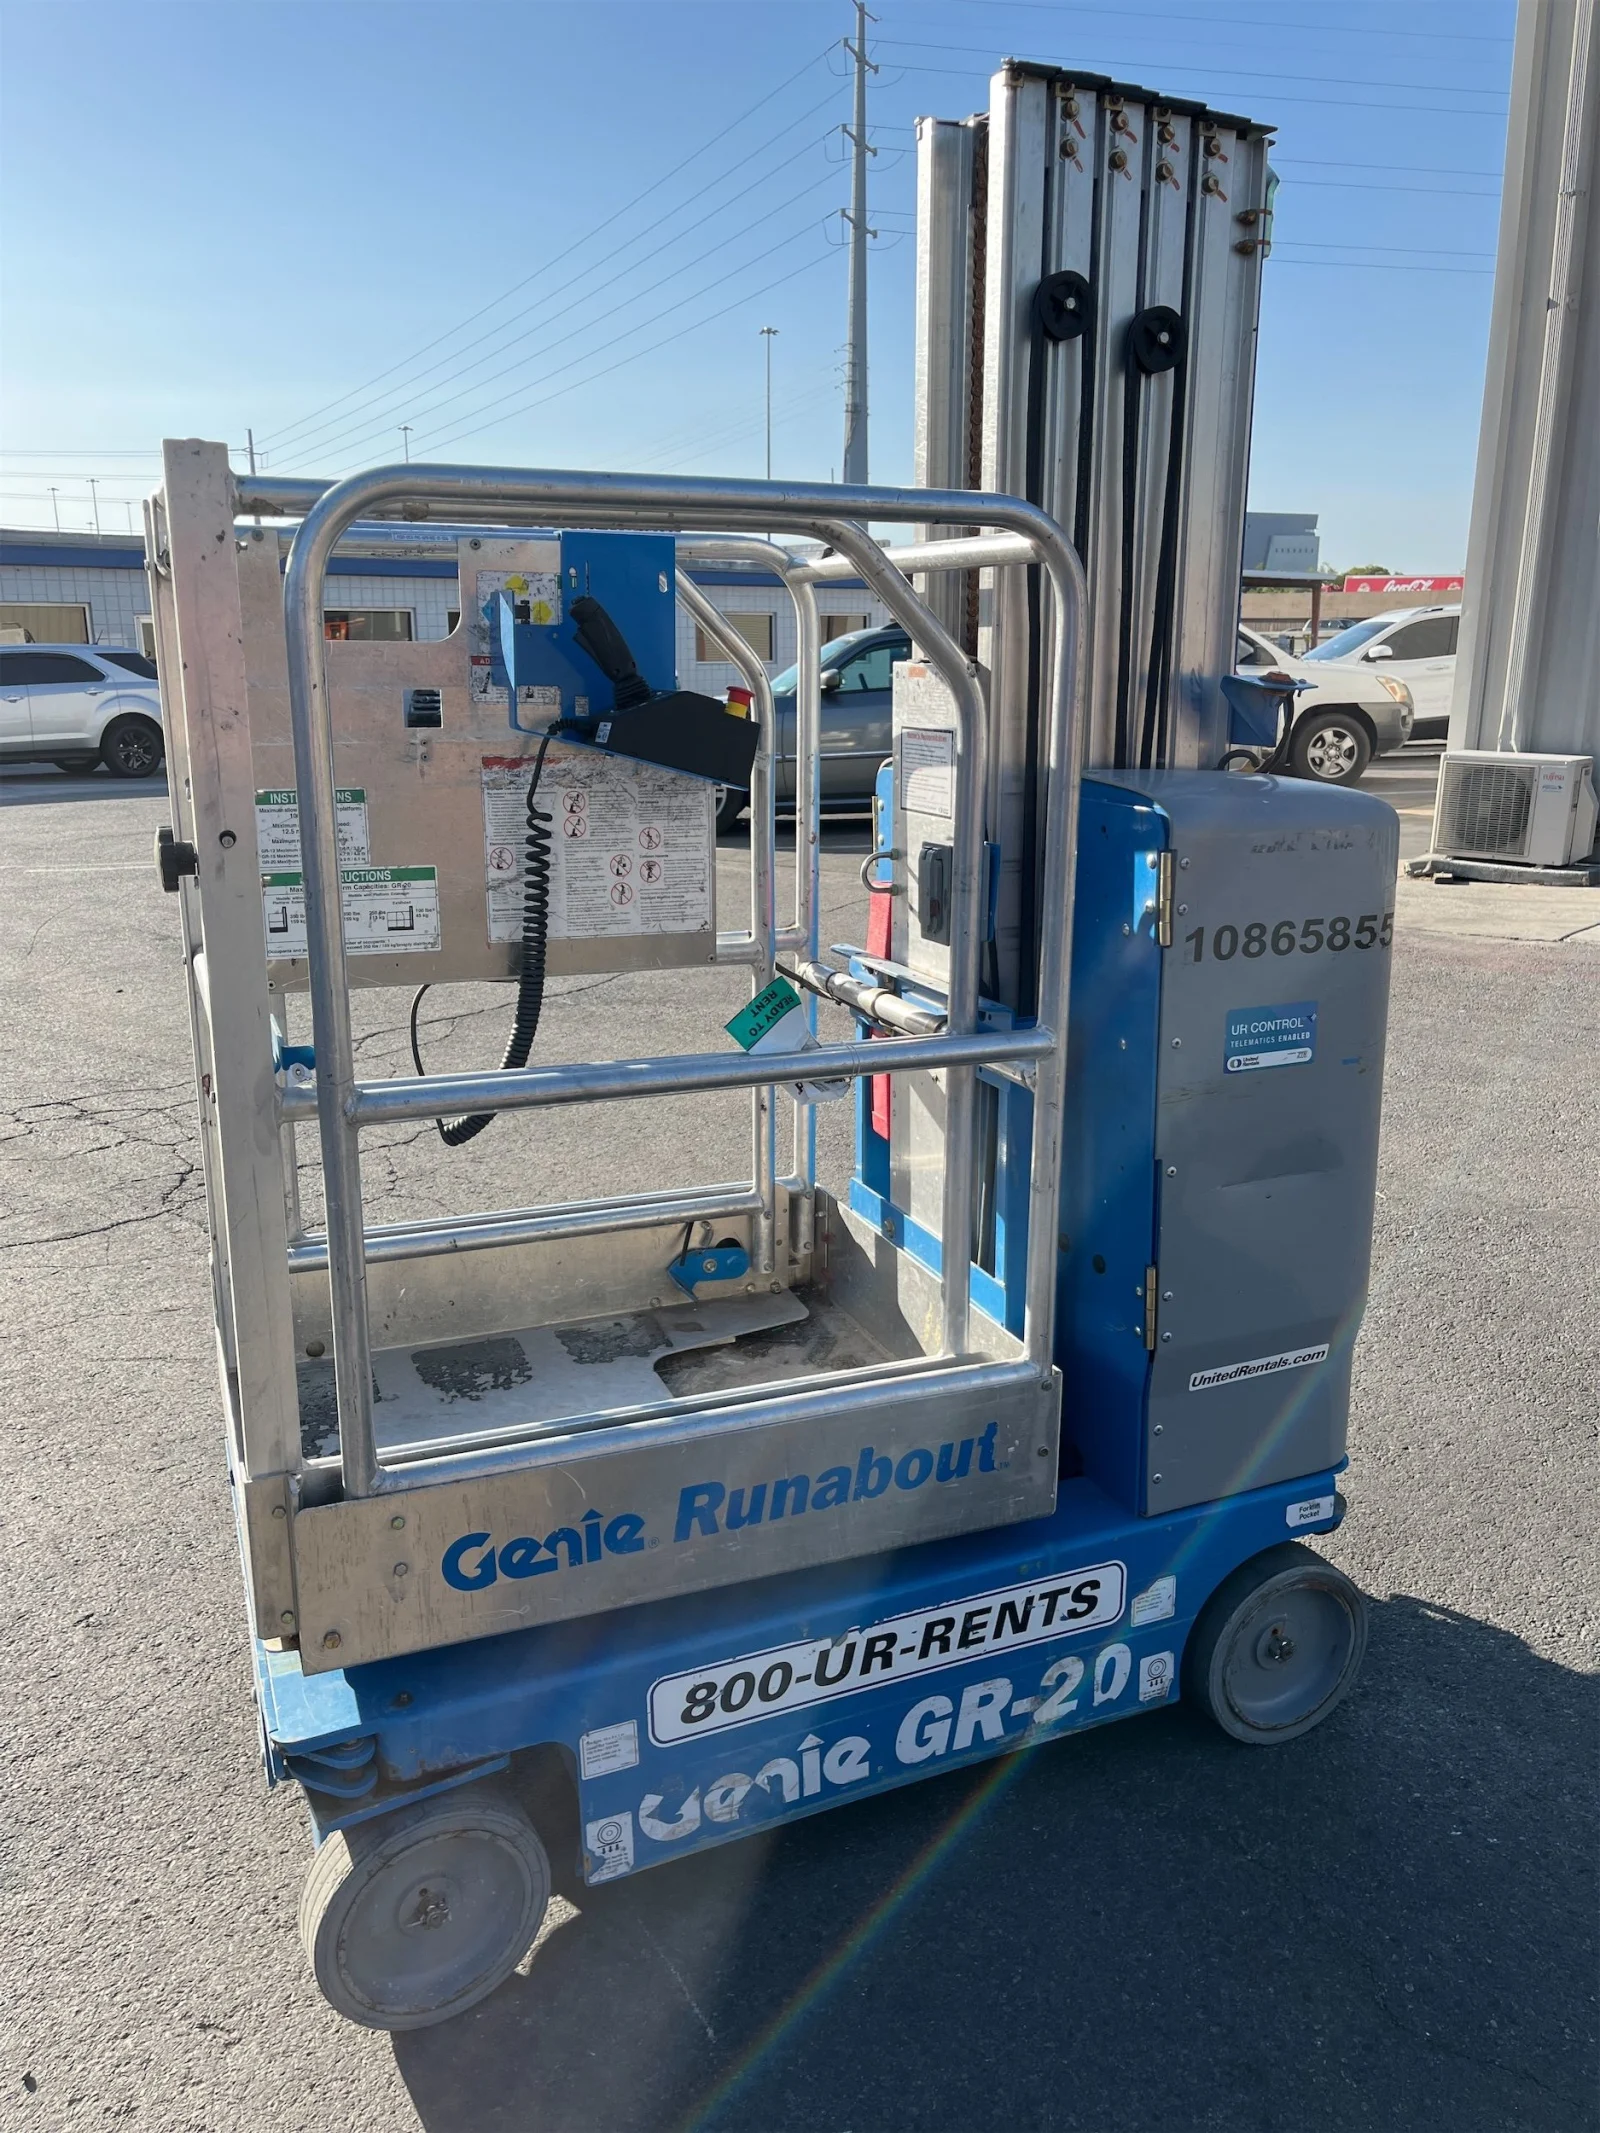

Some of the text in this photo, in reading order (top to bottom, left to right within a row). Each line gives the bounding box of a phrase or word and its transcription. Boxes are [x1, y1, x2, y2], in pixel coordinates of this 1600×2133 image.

[1185, 912, 1394, 963] 10865855
[748, 994, 795, 1037] READY TO
[749, 990, 778, 1018] RENT
[1230, 1031, 1310, 1048] TELEMATICS ENABLED
[1231, 1017, 1304, 1036] UR CONTROL
[1191, 1350, 1326, 1388] UnitedRentals.com
[441, 1421, 998, 1592] Genie Runabout
[1299, 1510, 1320, 1520] Pocket
[681, 1579, 1101, 1725] 800-UR-RENTS
[895, 1643, 1132, 1765] GR-20
